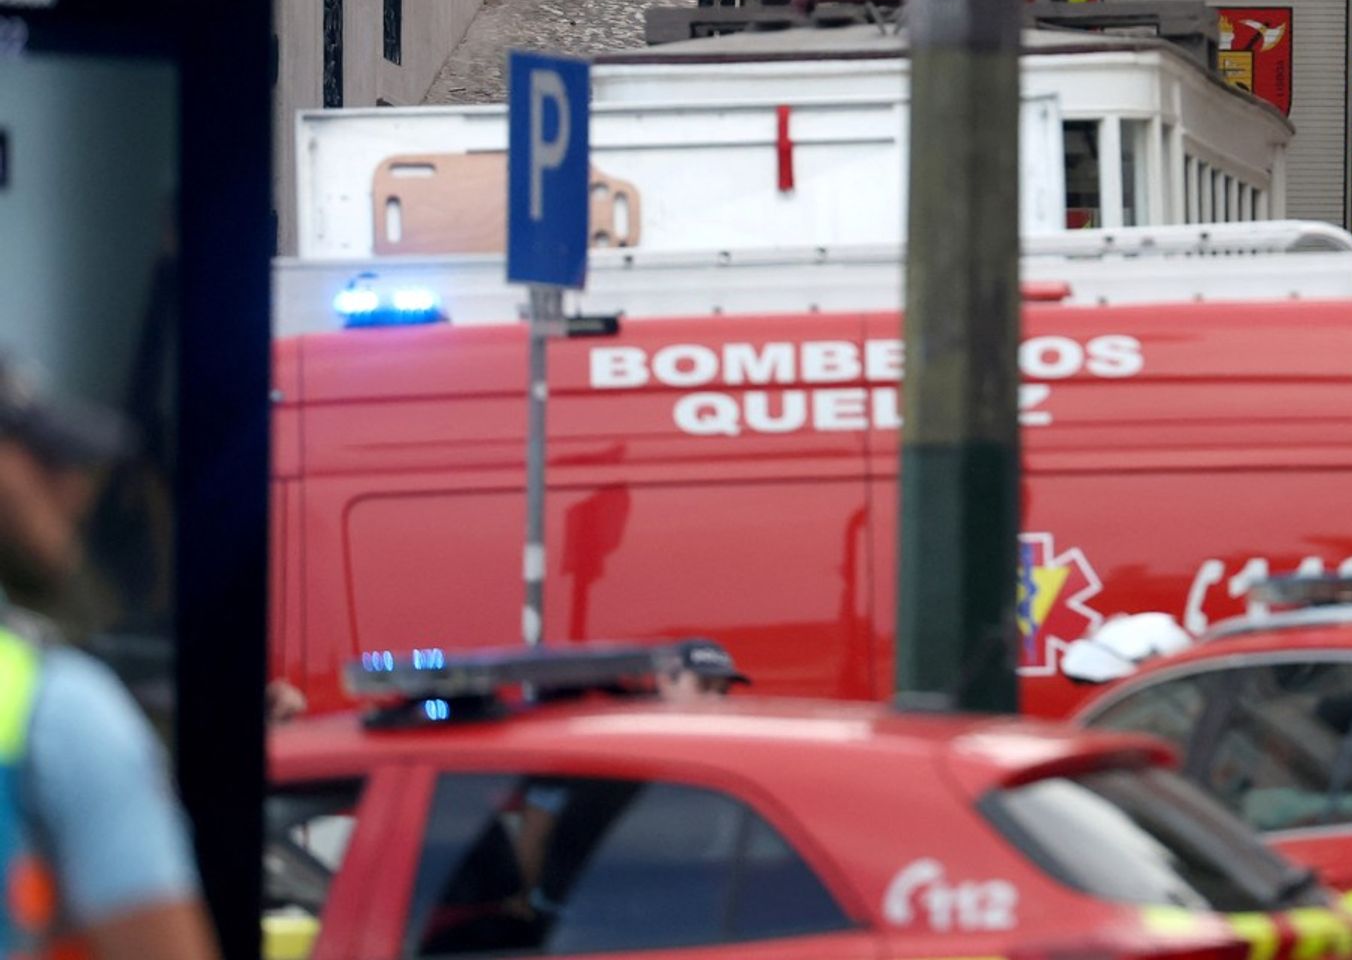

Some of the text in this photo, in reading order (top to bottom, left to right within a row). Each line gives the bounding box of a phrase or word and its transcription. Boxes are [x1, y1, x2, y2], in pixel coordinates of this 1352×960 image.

[529, 68, 572, 222] P
[589, 334, 1144, 389] BOMBEOS
[673, 382, 1053, 436] QUELZ
